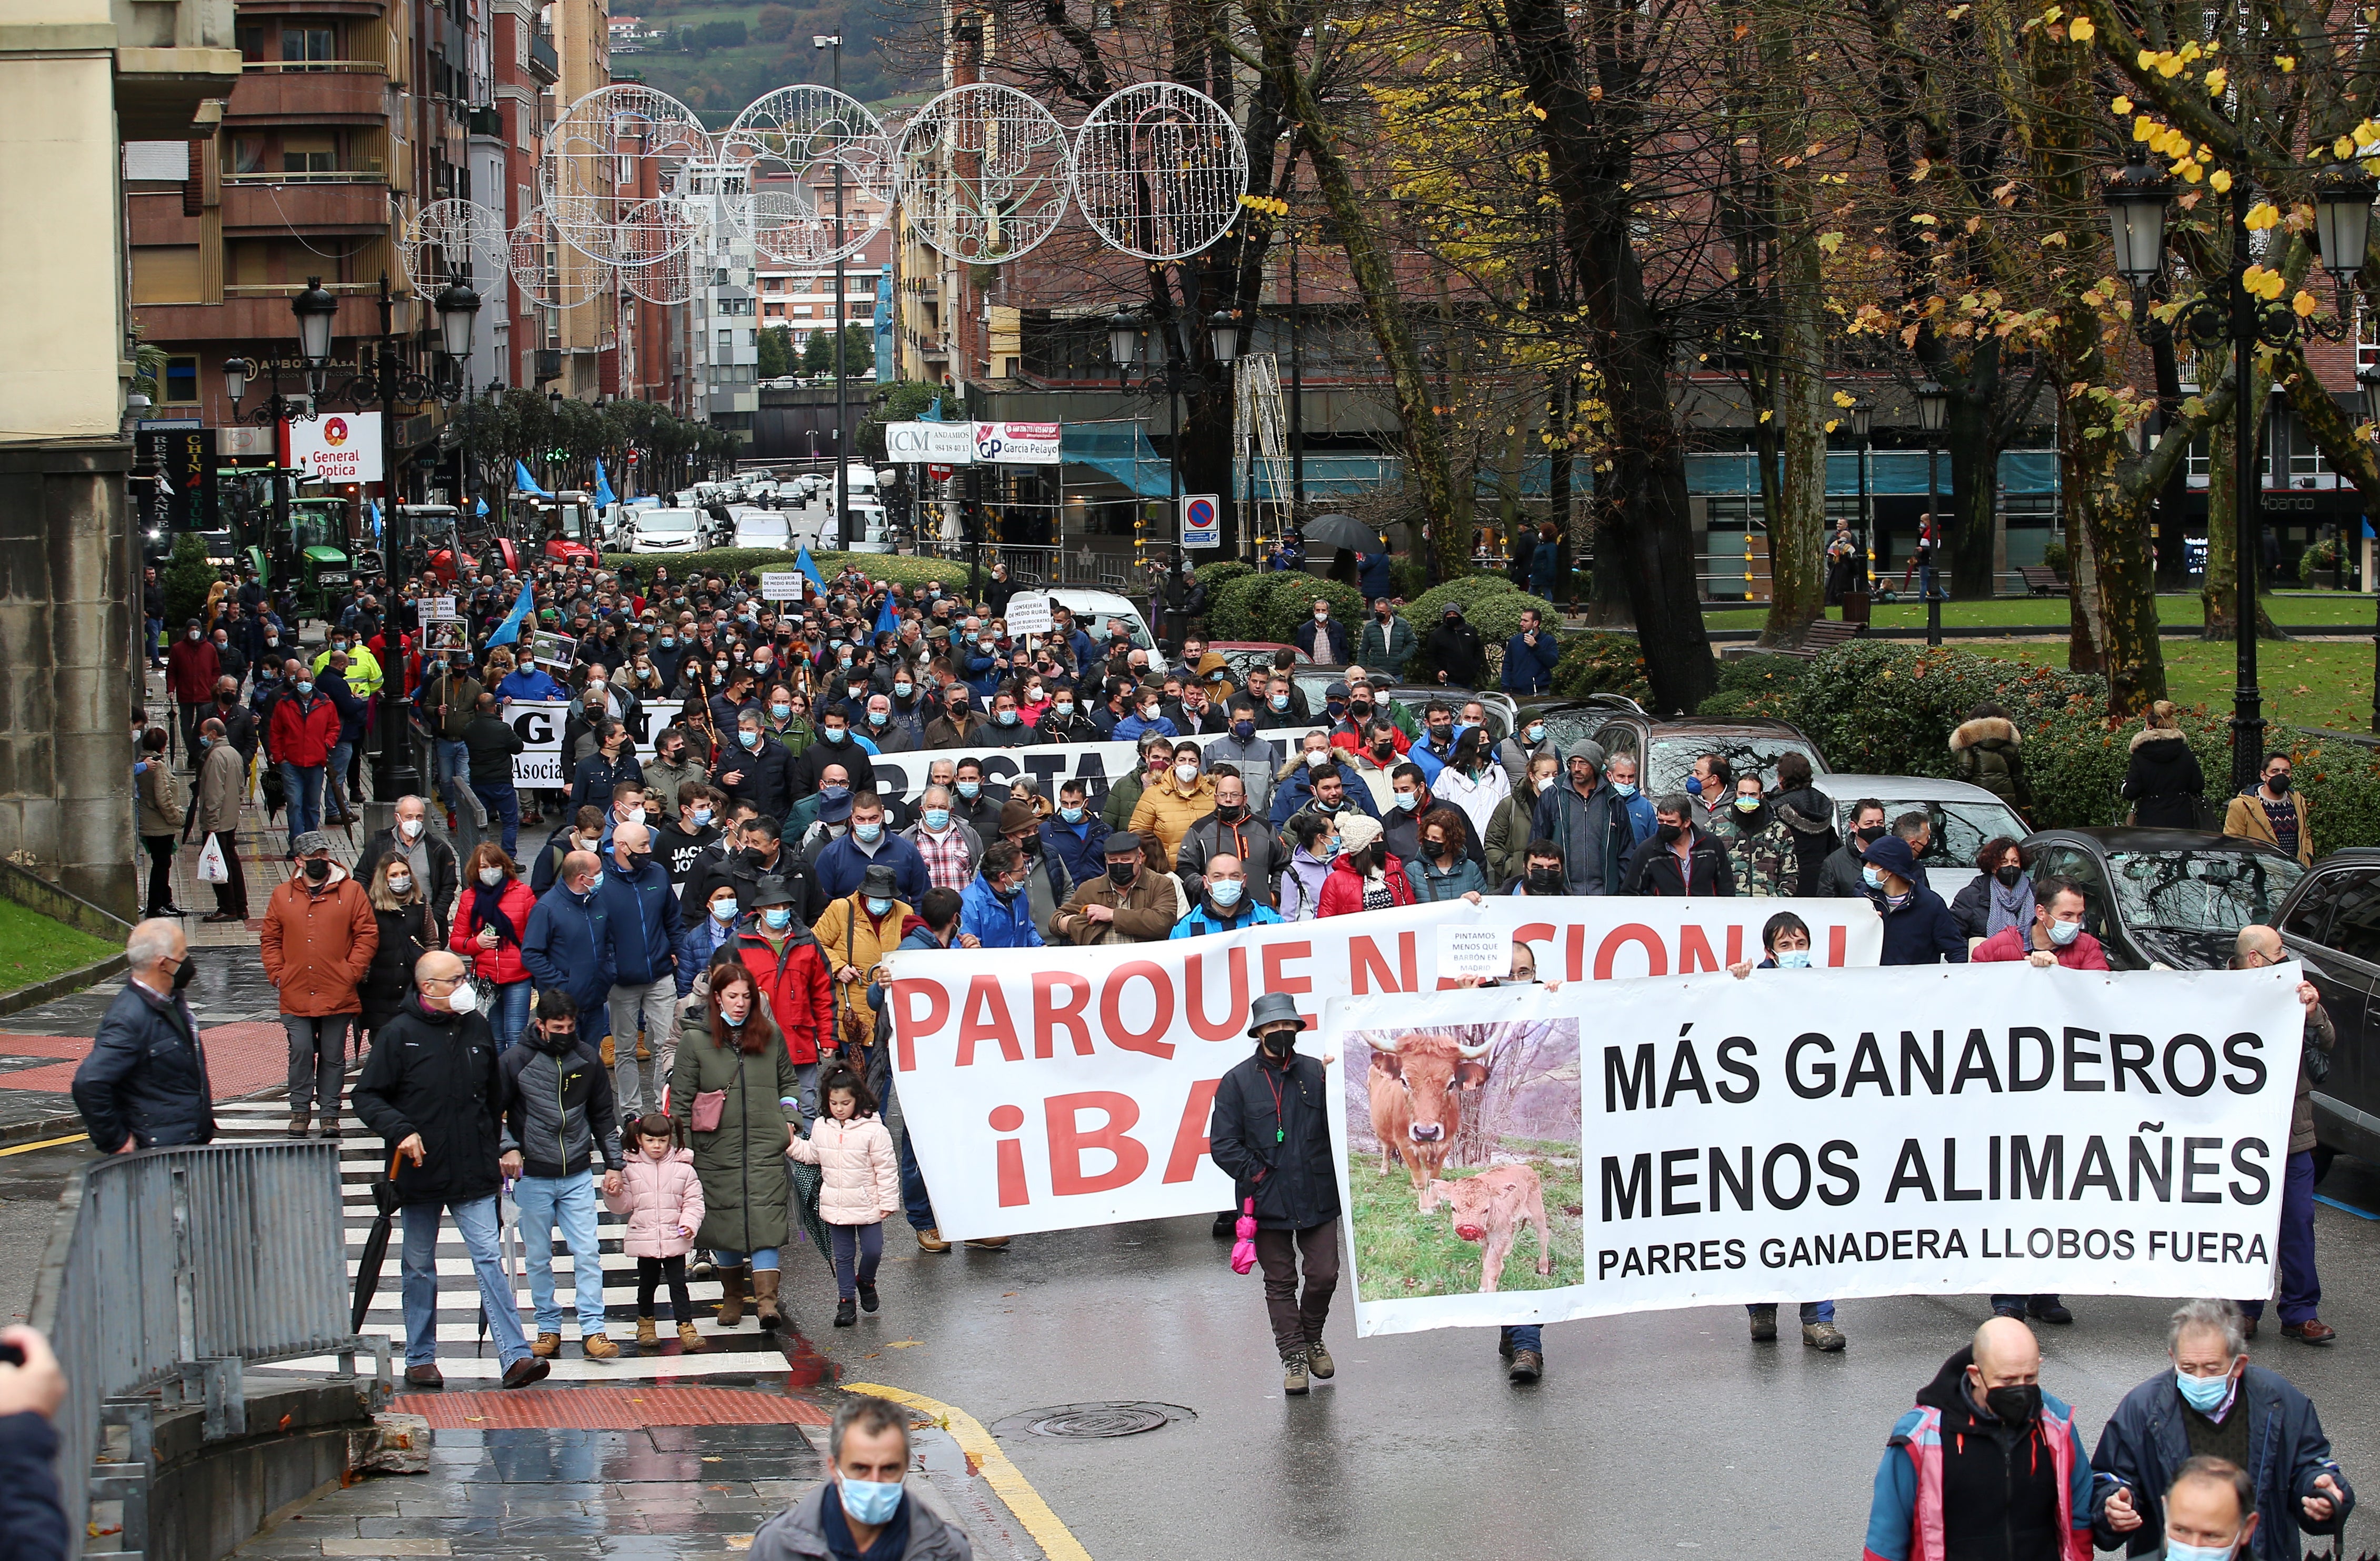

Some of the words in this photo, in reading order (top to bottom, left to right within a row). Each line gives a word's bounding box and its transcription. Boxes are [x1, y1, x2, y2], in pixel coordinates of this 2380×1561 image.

[887, 431, 930, 451] ICM
[979, 439, 1002, 458] GP
[1004, 443, 1028, 453] García
[1031, 443, 1057, 456] Pelayo
[313, 449, 360, 463] General
[1014, 602, 1042, 611] CONSEJERÍA
[1454, 953, 1485, 961] BARBÓN
[891, 940, 1318, 1072] PARQUE
[1604, 1023, 1759, 1112] MÁS
[1785, 1026, 2267, 1099] GANADEROS
[1601, 1139, 1860, 1222] MENOS
[1884, 1121, 2270, 1205] ALIMAÑES
[1599, 1239, 1746, 1280] PARRES
[1760, 1228, 1968, 1268] GANADERA
[1982, 1228, 2135, 1260] LLOBOS
[2149, 1230, 2268, 1264] FUERA
